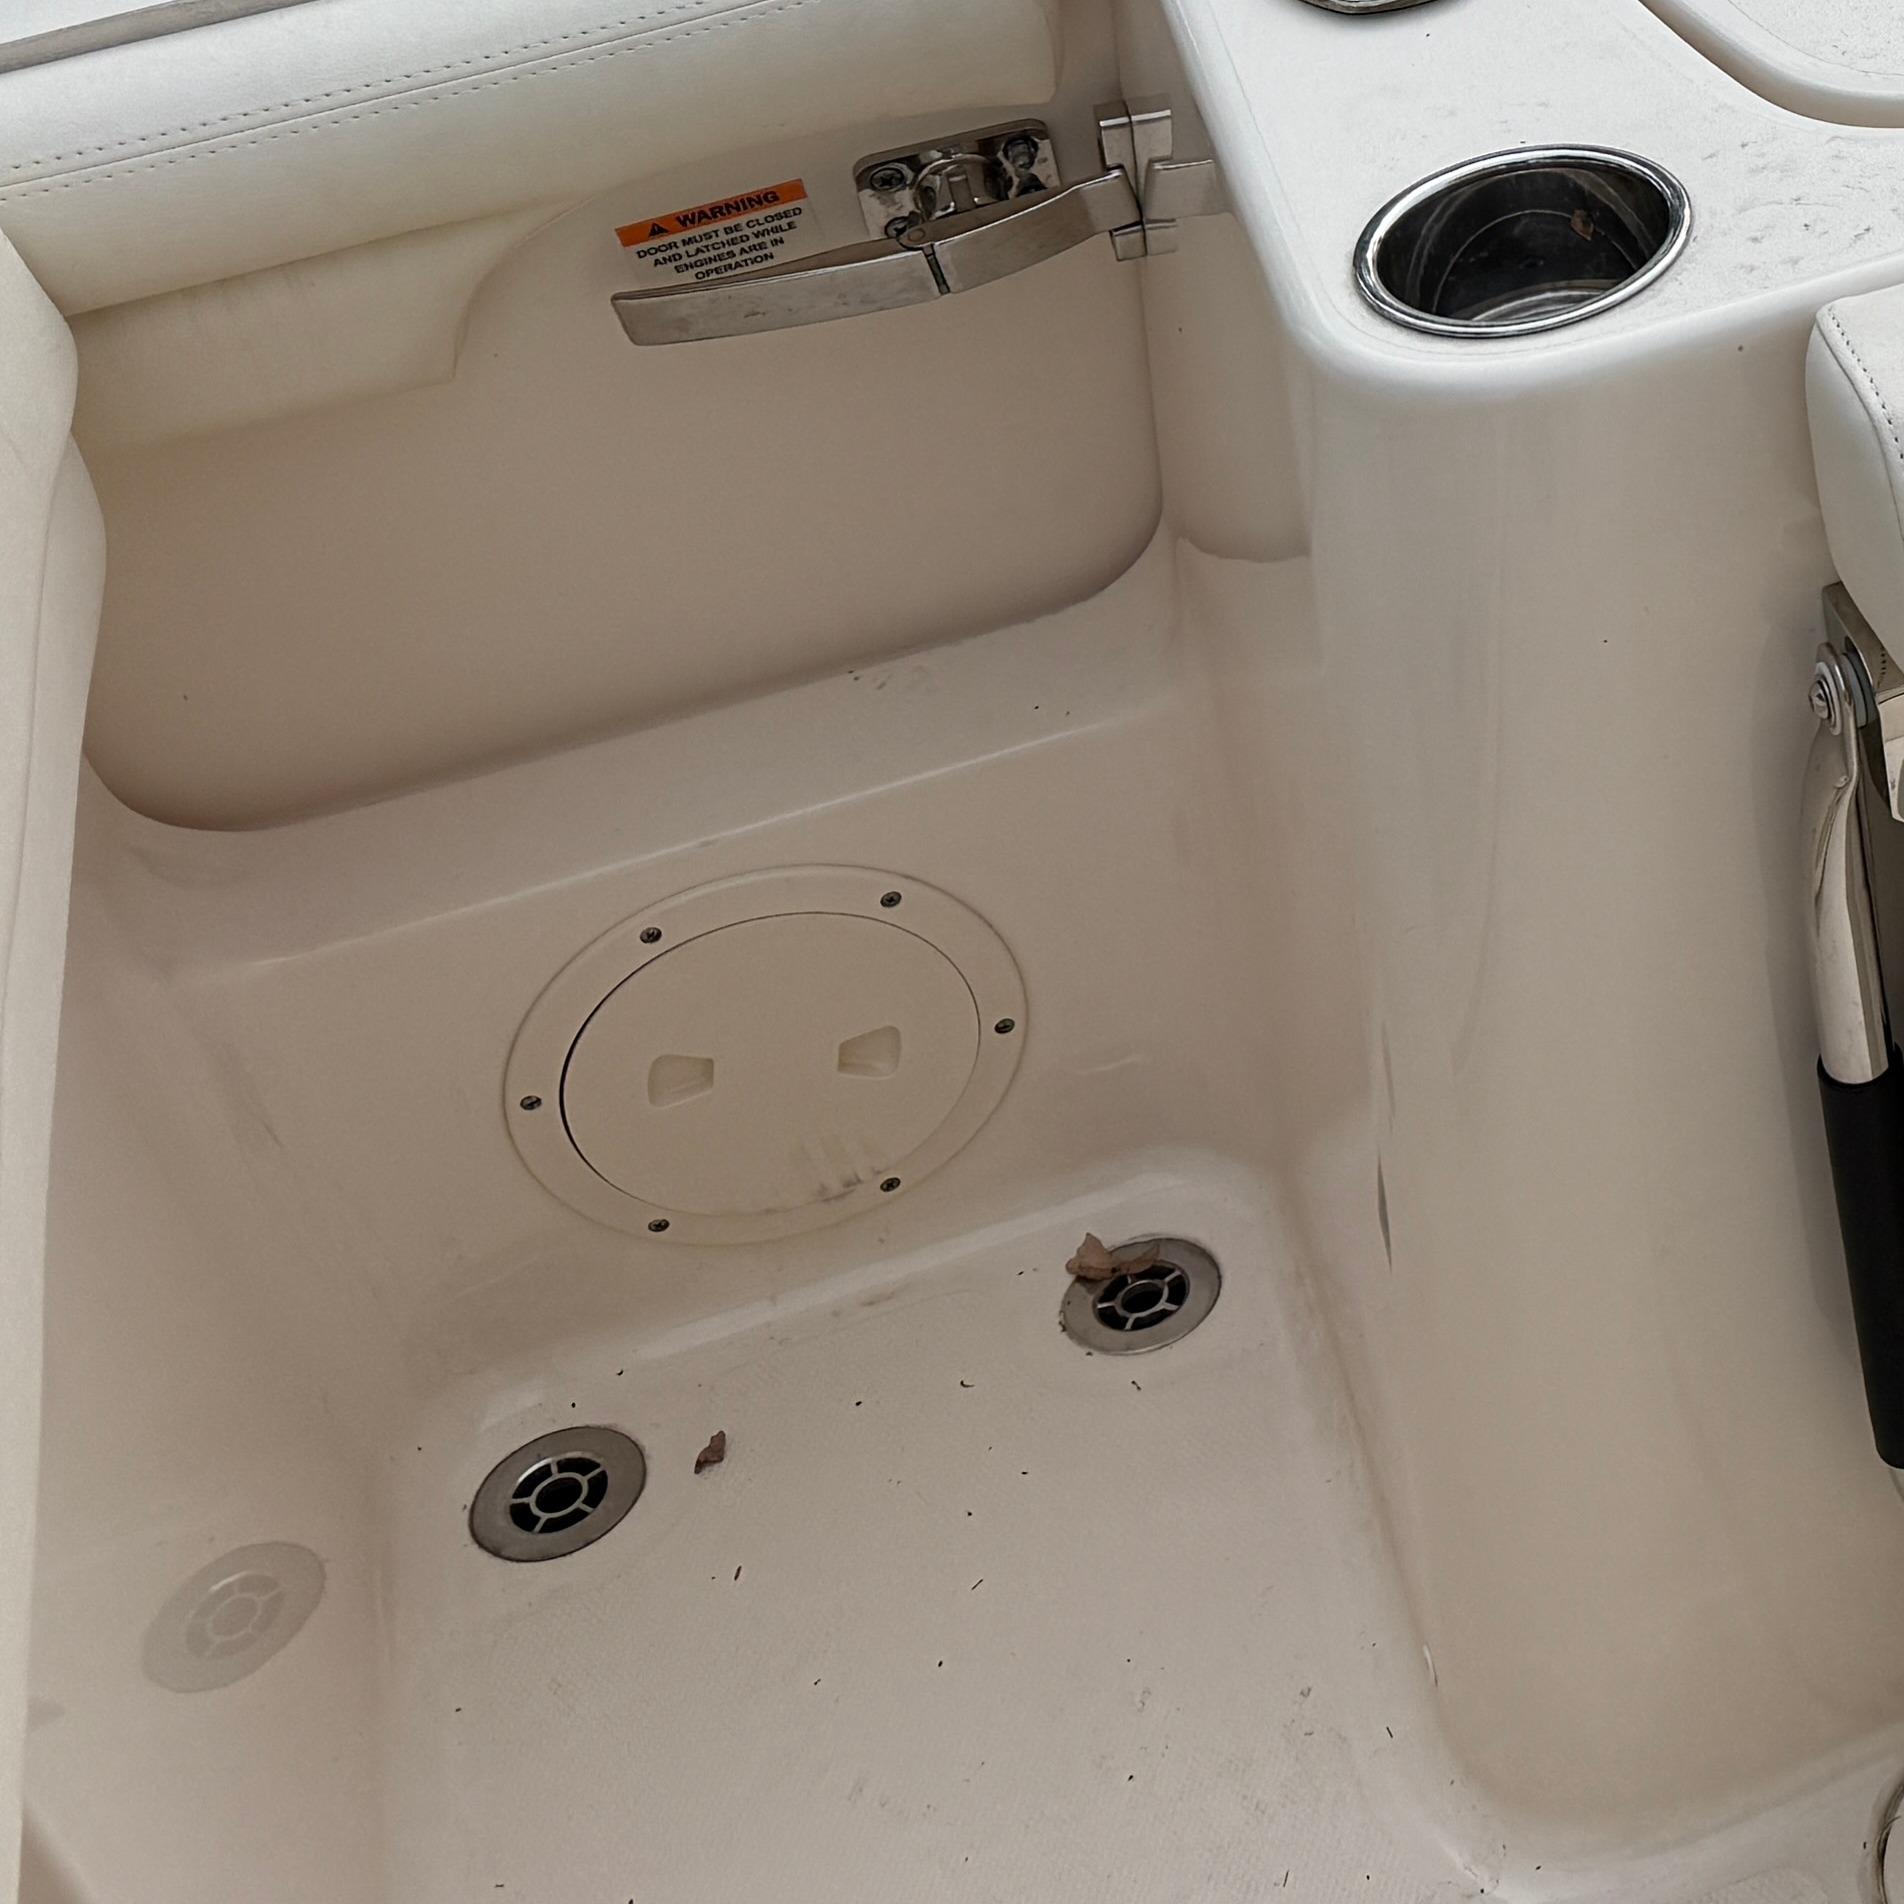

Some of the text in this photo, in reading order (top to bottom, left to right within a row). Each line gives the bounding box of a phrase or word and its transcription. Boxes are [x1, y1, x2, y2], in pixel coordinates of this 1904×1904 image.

[675, 190, 781, 228] WARNING
[636, 206, 803, 259] DOOR MUST BE CLOSED
[653, 220, 798, 267] AND LATCHED WHILE
[674, 236, 785, 274] ENGINES ARE IN
[694, 252, 775, 281] OPERATION
